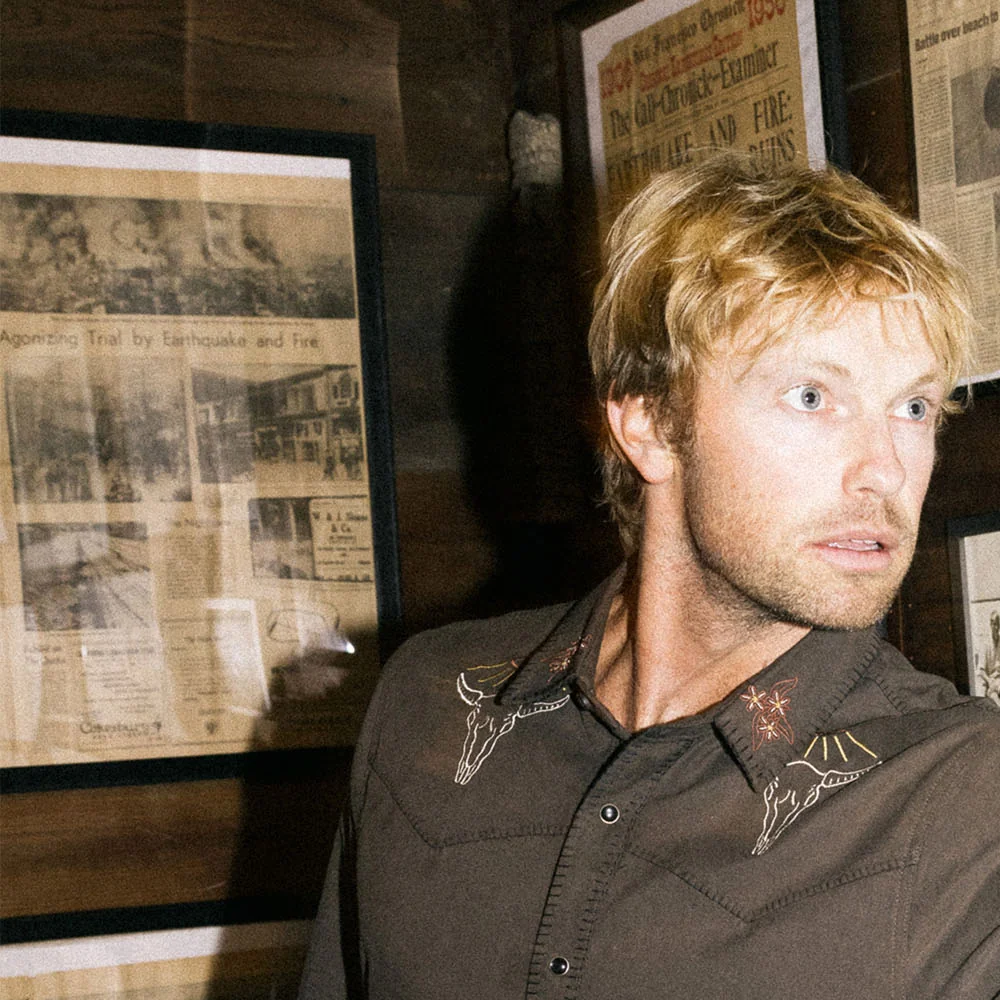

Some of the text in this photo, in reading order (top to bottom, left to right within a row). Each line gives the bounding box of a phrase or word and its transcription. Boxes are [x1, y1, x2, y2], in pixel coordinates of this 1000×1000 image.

[914, 32, 940, 52] Battle
[940, 26, 961, 42] over
[962, 12, 990, 34] beach
[990, 10, 1000, 23] to
[708, 113, 738, 150] AND
[87, 328, 122, 346] Trial
[132, 329, 154, 349] by
[162, 330, 247, 349] Earthquake
[256, 330, 284, 348] and
[292, 331, 320, 348] Fire
